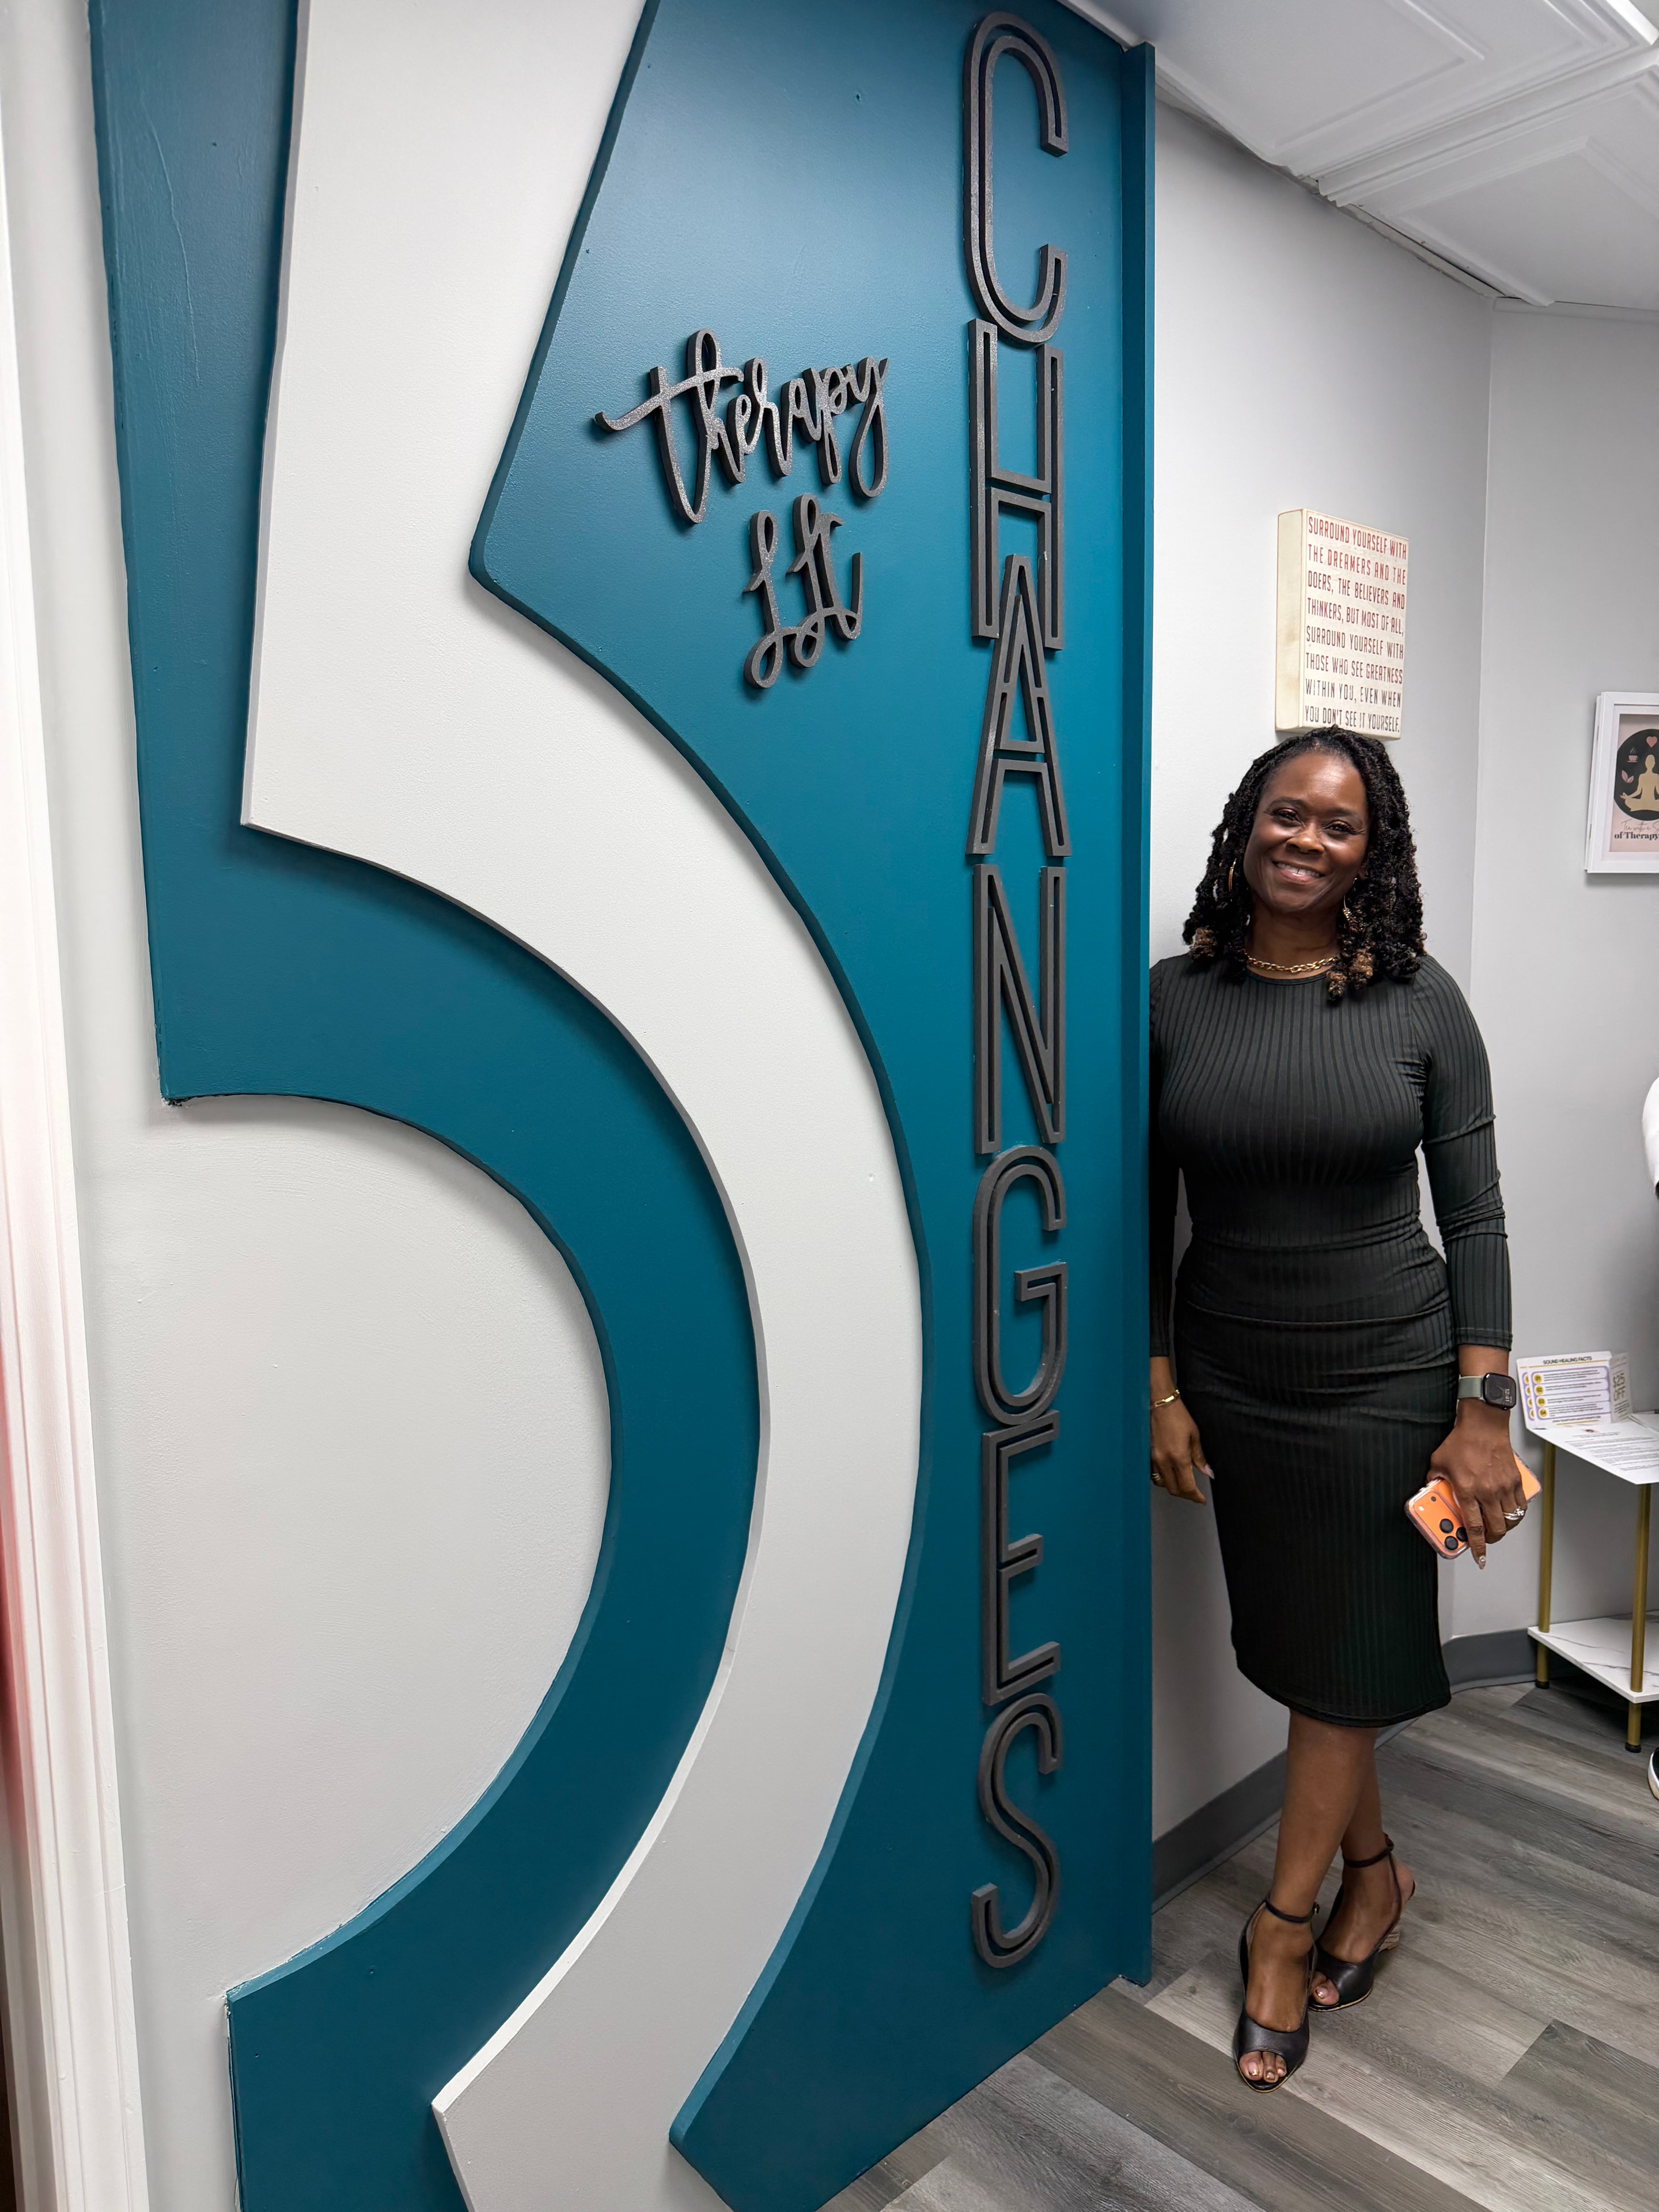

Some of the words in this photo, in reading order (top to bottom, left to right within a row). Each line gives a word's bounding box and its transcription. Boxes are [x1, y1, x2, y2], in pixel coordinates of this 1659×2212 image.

[593, 328, 889, 524] therapy
[1309, 517, 1349, 543] SURROUND
[1353, 529, 1387, 554] YOURSELF
[1390, 540, 1406, 560] WITH
[1308, 544, 1323, 564] THE
[1328, 549, 1370, 576] DREAMERS
[1374, 562, 1389, 581] AND
[1393, 567, 1406, 585] THE
[1308, 570, 1334, 594] DOERS,
[1338, 578, 1350, 596] THE
[1355, 582, 1389, 605] BELIEVERS
[1392, 592, 1405, 609] AND
[1308, 598, 1343, 624] THINKERS,
[1346, 607, 1359, 624] BUT
[1362, 610, 1379, 629] MOST
[1381, 615, 1389, 631] OF
[1391, 617, 1404, 637] ALL,
[1306, 626, 1346, 649] SURROUND
[1350, 634, 1383, 656] YOURSELF
[1387, 642, 1404, 660] WITH
[1306, 653, 1329, 672] THOSE
[1332, 657, 1348, 675] WHO
[1351, 661, 1363, 677] SEE
[1366, 664, 1403, 684] GREATNESS
[1306, 679, 1335, 698] WITHIN
[1339, 683, 1357, 704] YOU,
[1361, 687, 1378, 704] EVEN
[1382, 690, 1401, 708] WHEN
[1305, 706, 1319, 722] YOU
[1323, 708, 1343, 726] DON'T
[1346, 710, 1357, 727] SEE
[1359, 713, 1365, 728] IT
[1368, 713, 1400, 733] YOURSELF.
[963, 9, 1072, 1970] CHANGES
